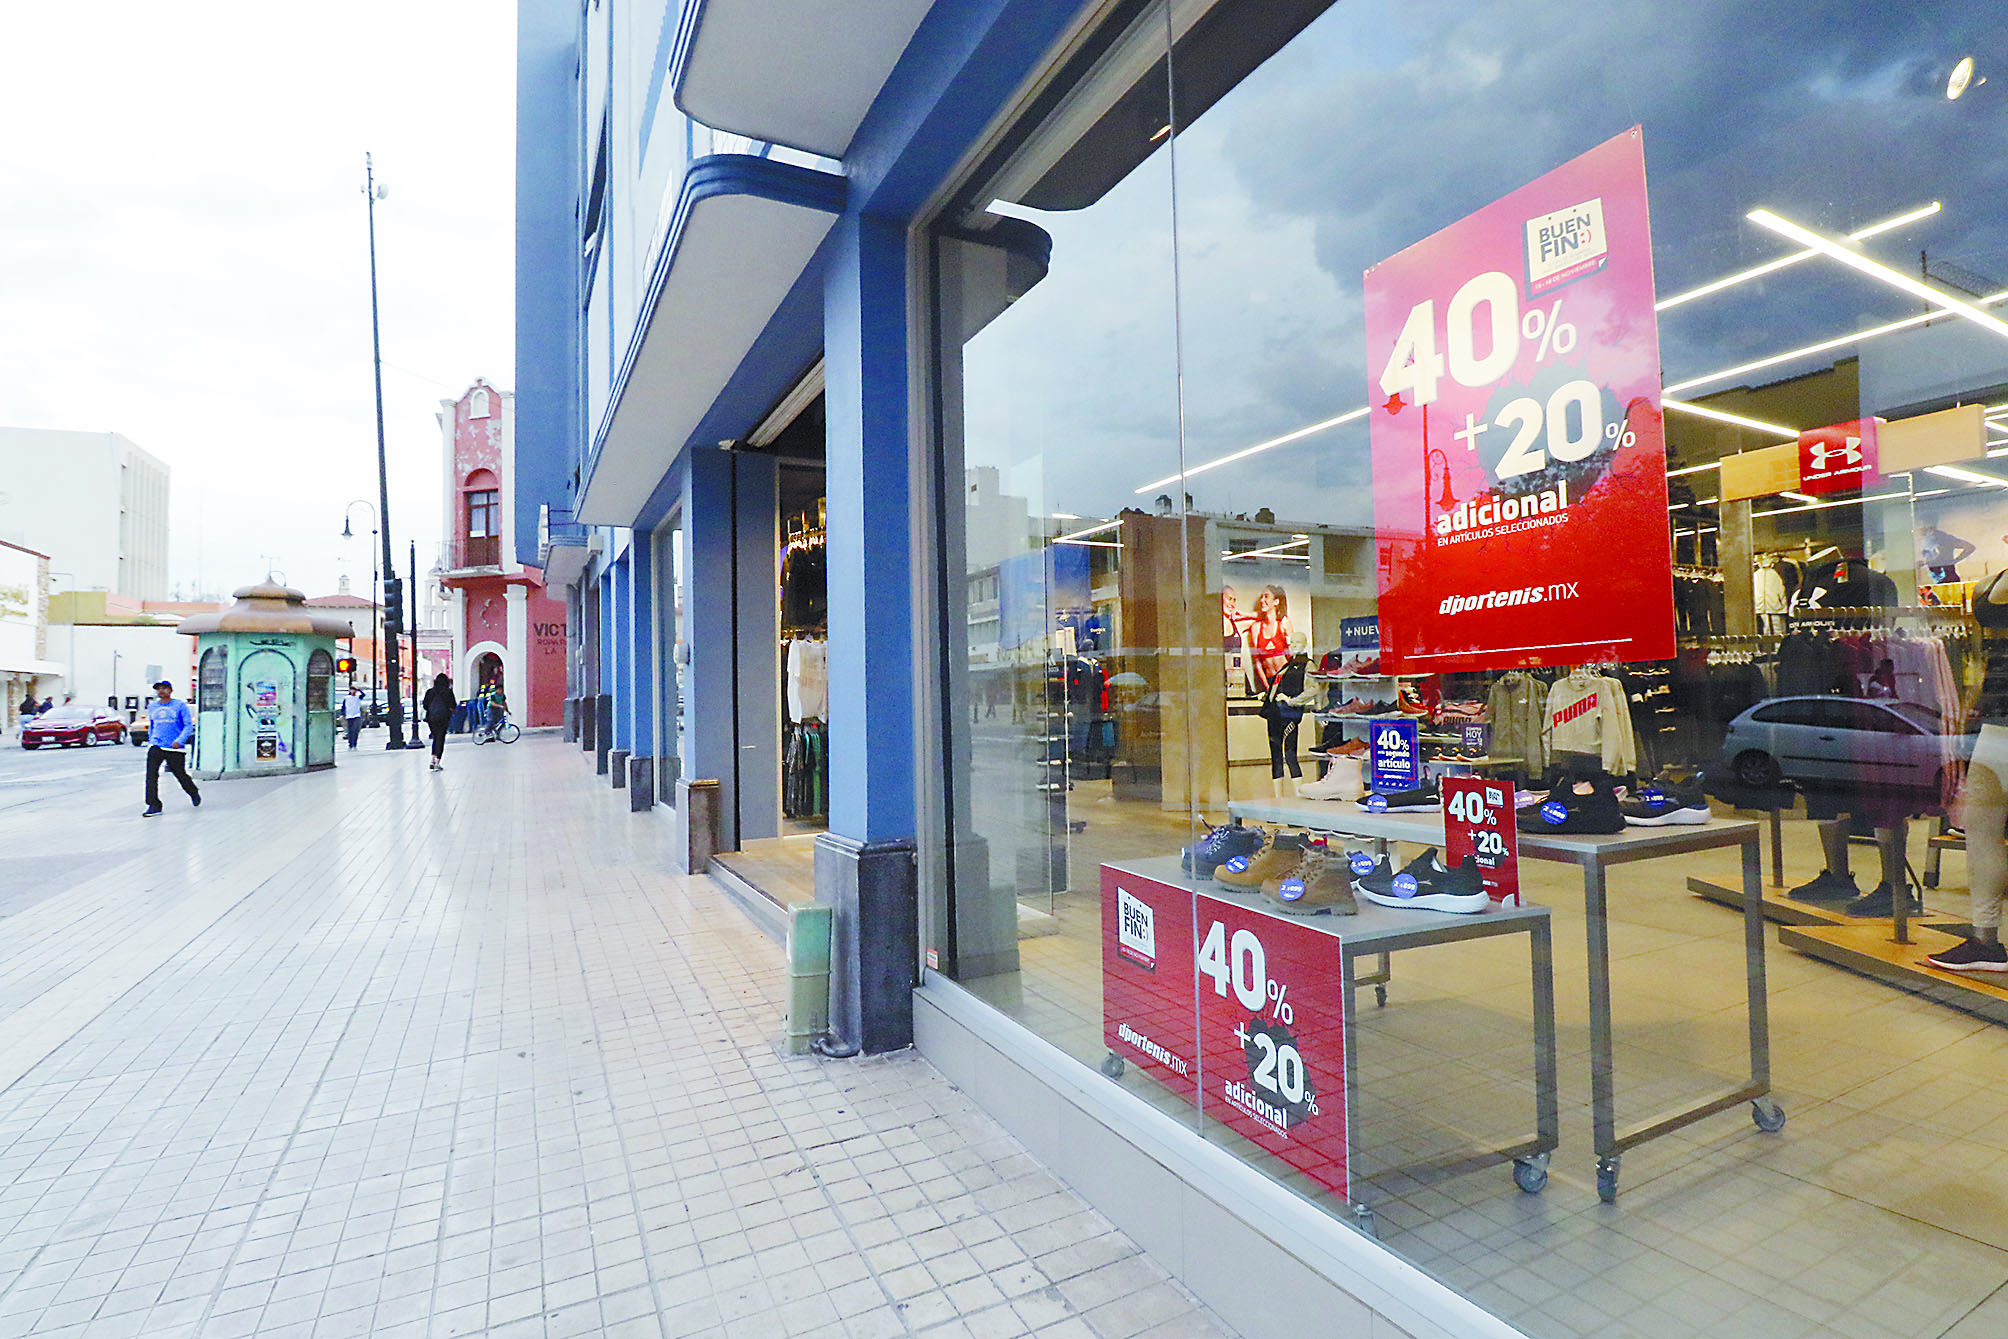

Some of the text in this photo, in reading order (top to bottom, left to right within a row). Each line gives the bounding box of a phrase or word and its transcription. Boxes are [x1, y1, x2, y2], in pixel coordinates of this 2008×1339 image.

[1539, 213, 1591, 244] BUEN
[1379, 271, 1577, 408] 40%
[1437, 480, 1568, 535] adicional
[1437, 513, 1568, 547] EN ARTÍCULOS SELECCIONADOS
[1552, 692, 1598, 728] PUMA
[1377, 730, 1410, 751] 40%
[1447, 790, 1498, 826] 40%
[1123, 902, 1149, 927] BUEN
[1198, 920, 1294, 1025] 40%
[1225, 1080, 1288, 1130] adicional
